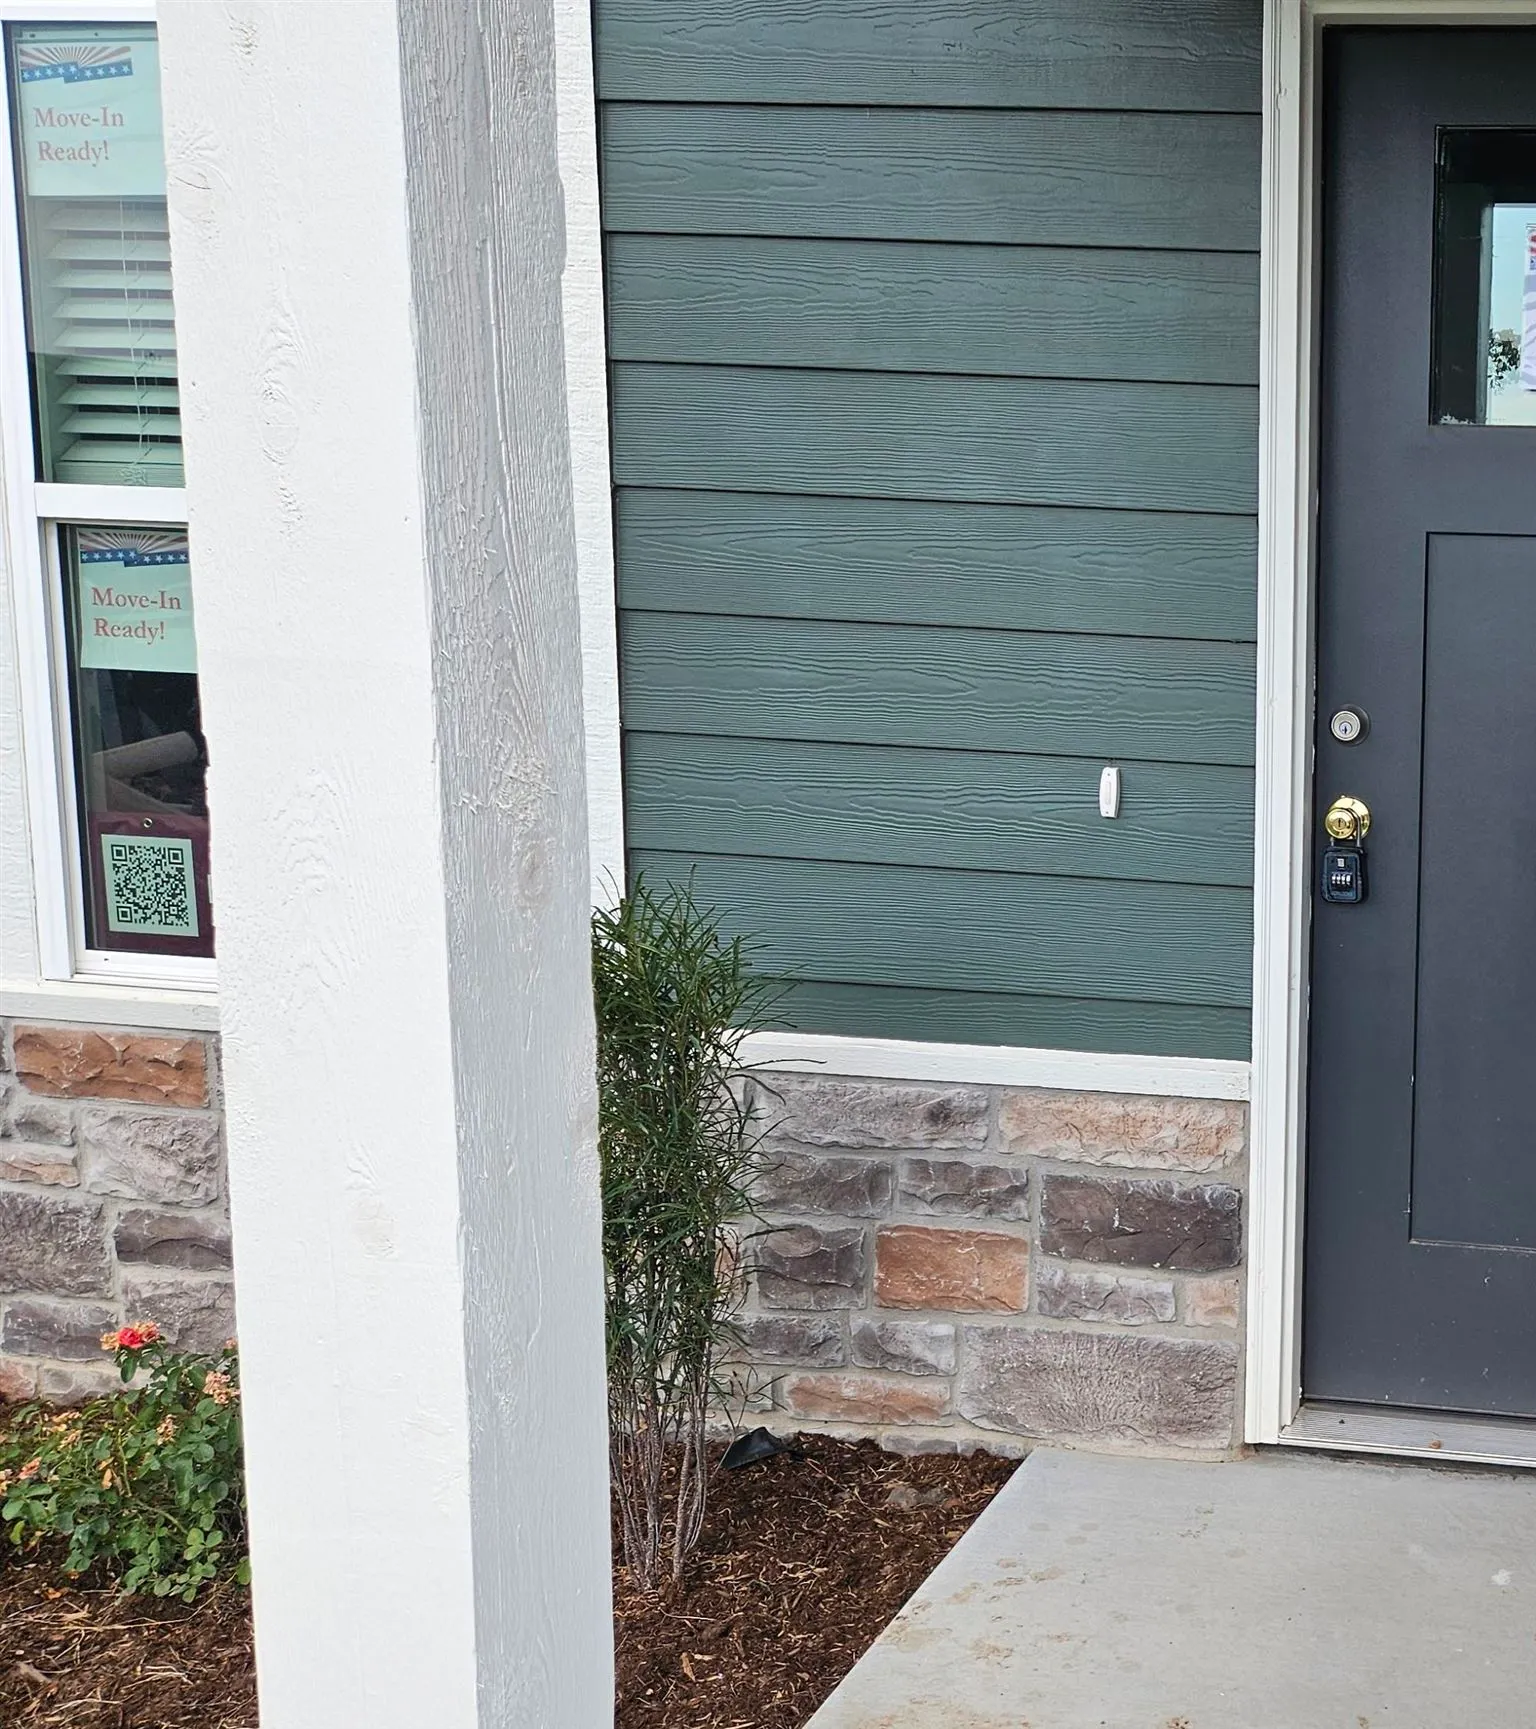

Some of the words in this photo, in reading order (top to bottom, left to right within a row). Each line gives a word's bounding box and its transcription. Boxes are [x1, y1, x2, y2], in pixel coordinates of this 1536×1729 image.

[33, 106, 125, 128] Move-In
[37, 139, 110, 168] Ready!
[91, 587, 182, 610] Move-In
[93, 617, 165, 645] Ready!
